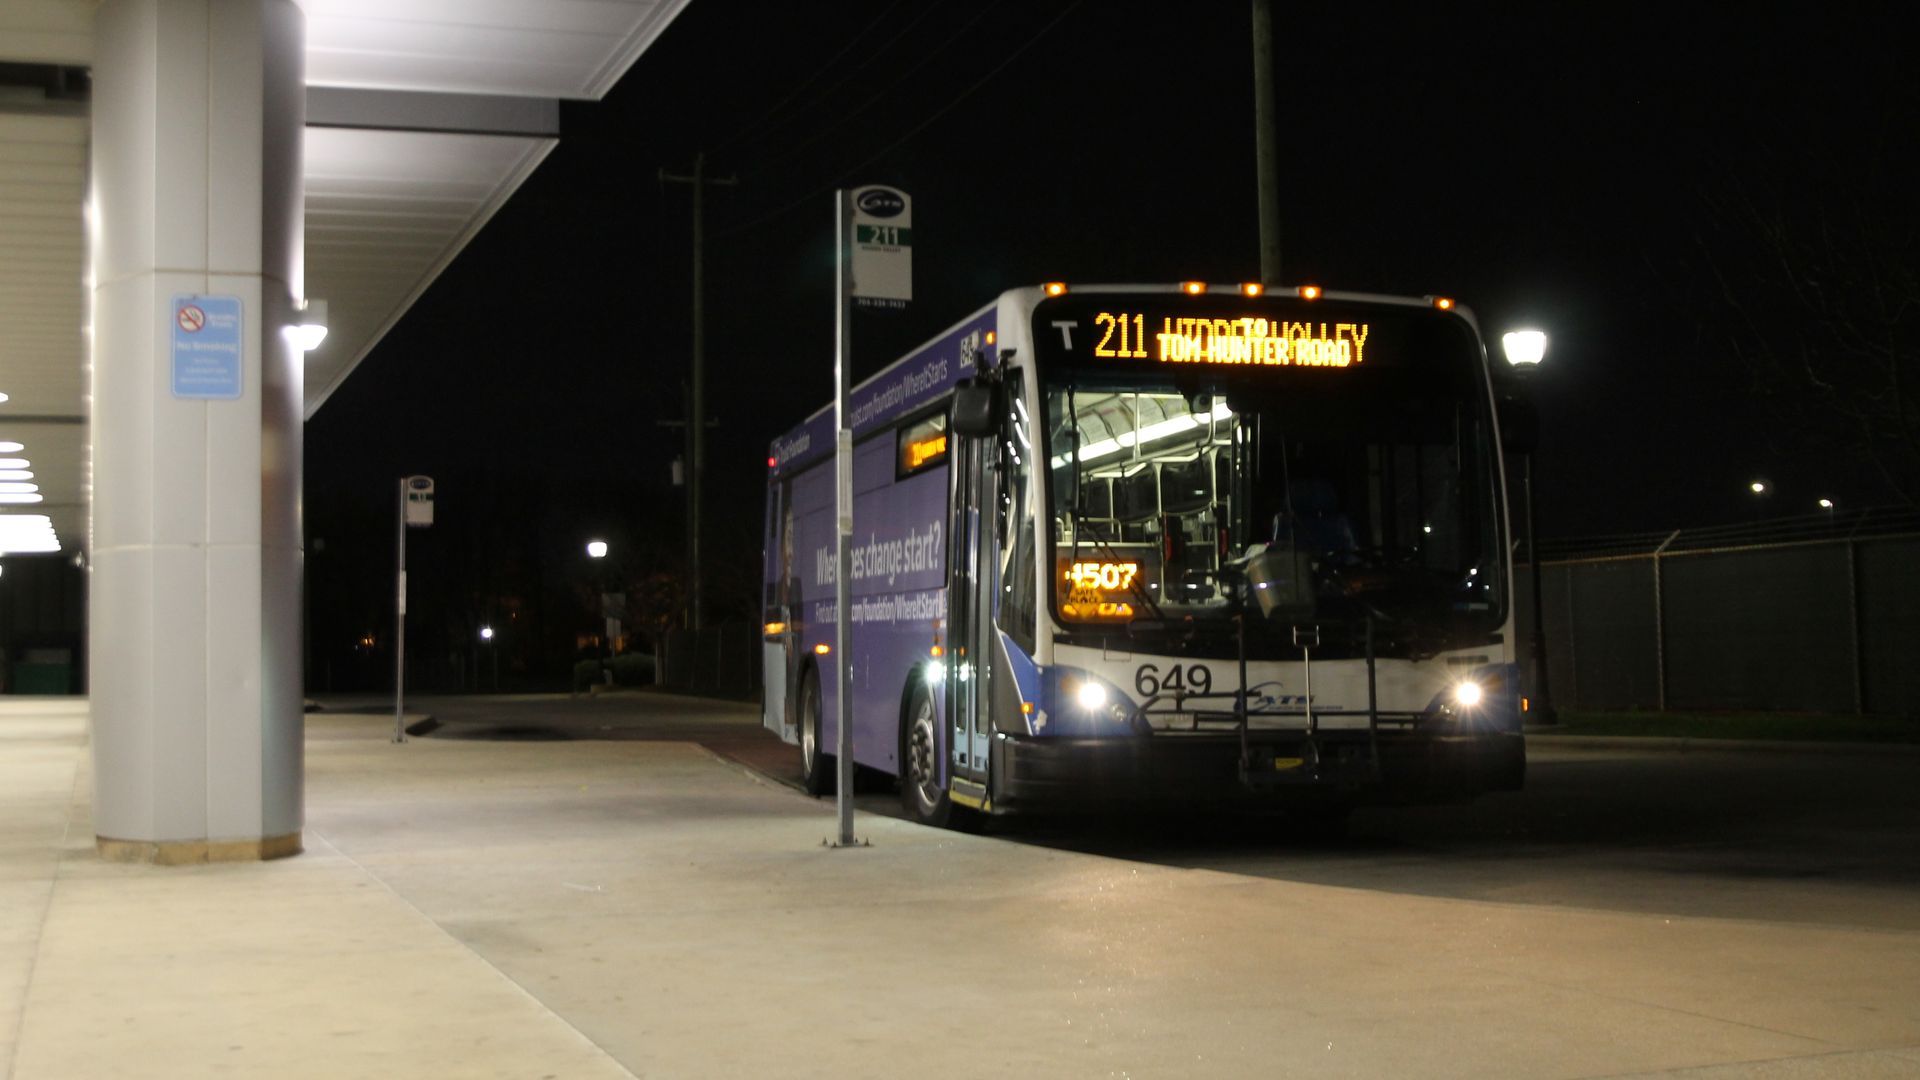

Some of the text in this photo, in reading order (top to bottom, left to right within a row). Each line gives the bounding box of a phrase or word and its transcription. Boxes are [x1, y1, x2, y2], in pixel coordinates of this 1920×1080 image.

[871, 226, 898, 245] 211
[1095, 312, 1148, 358] 211
[1157, 333, 1351, 367] TOM HUNTER ROAD
[817, 520, 942, 586] Wher oes change start?
[1135, 664, 1212, 697] 649
